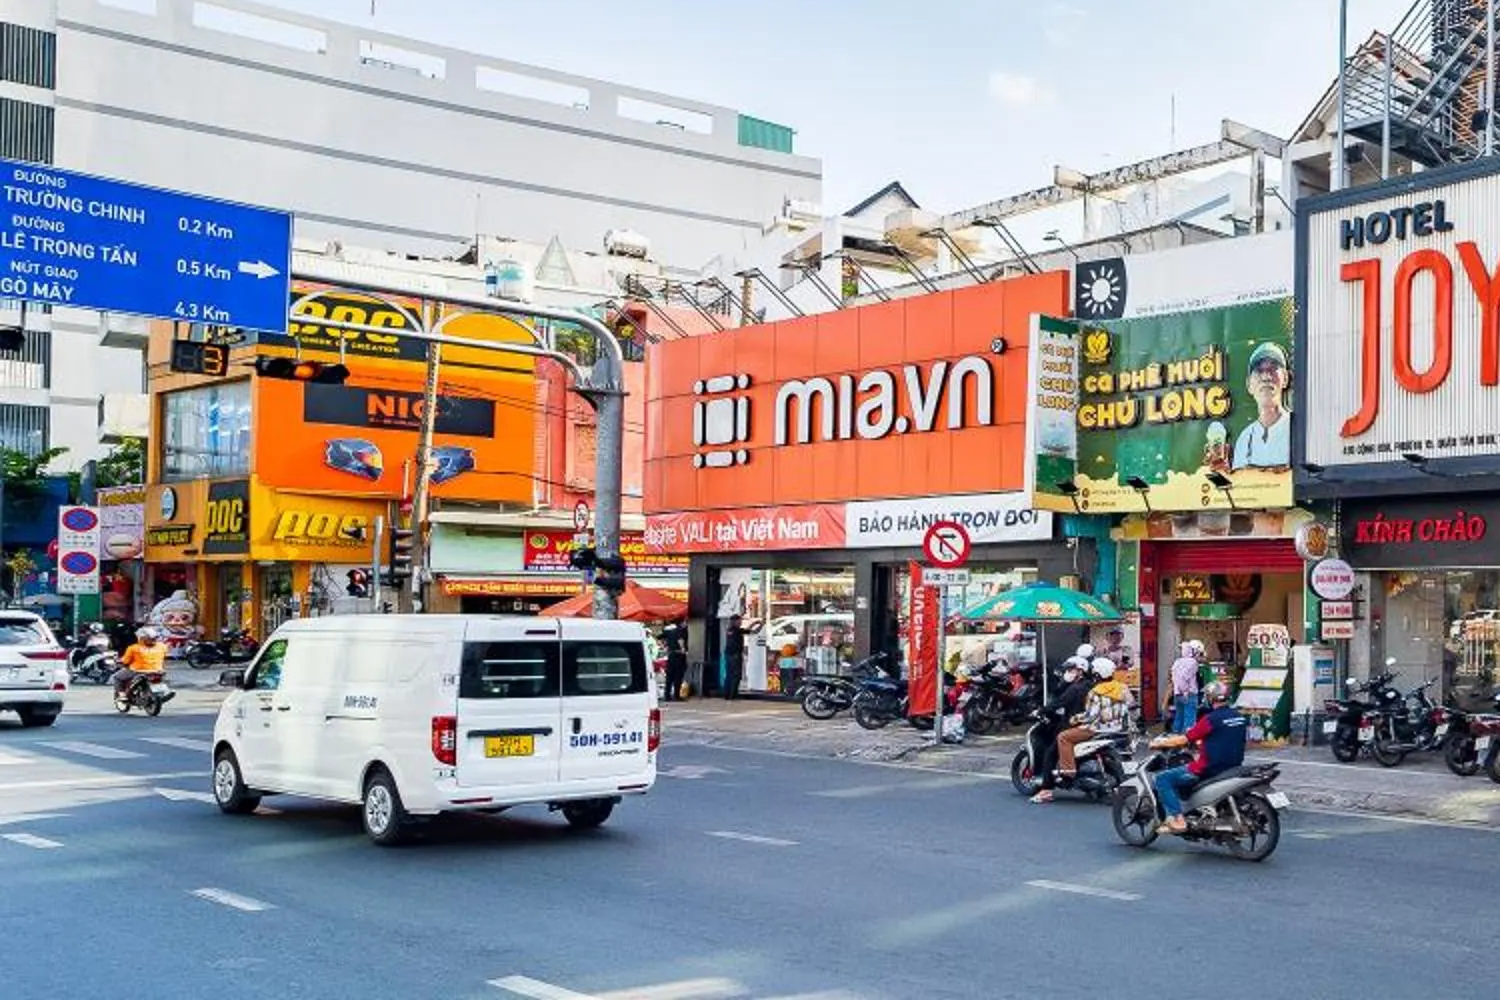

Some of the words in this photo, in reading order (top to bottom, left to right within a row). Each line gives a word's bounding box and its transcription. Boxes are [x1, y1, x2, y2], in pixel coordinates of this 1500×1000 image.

[4, 185, 83, 213] TRƯỜNG
[89, 201, 145, 224] CHINH
[178, 217, 201, 235] 0.2
[206, 222, 233, 240] Km
[1340, 200, 1455, 250] HOTEL
[1, 230, 25, 249] LÊ
[31, 235, 95, 259] TRỌNG
[101, 243, 138, 267] TẤN
[11, 260, 41, 275] NÚT
[44, 265, 79, 281] GIAO
[177, 259, 200, 275] 0.5
[205, 264, 231, 281] Km
[1, 275, 27, 295] GÒ
[33, 282, 75, 301] MÂY
[176, 301, 198, 318] 4.3
[203, 305, 230, 322] Km
[774, 355, 993, 446] mia.vn
[1078, 395, 1136, 427] CHÚ
[1145, 384, 1231, 423] LONG
[680, 521, 713, 543] VALI
[742, 519, 774, 546] Việt
[778, 516, 817, 540] Nam
[1354, 512, 1413, 544] KÍNH
[1249, 631, 1289, 646] 50%
